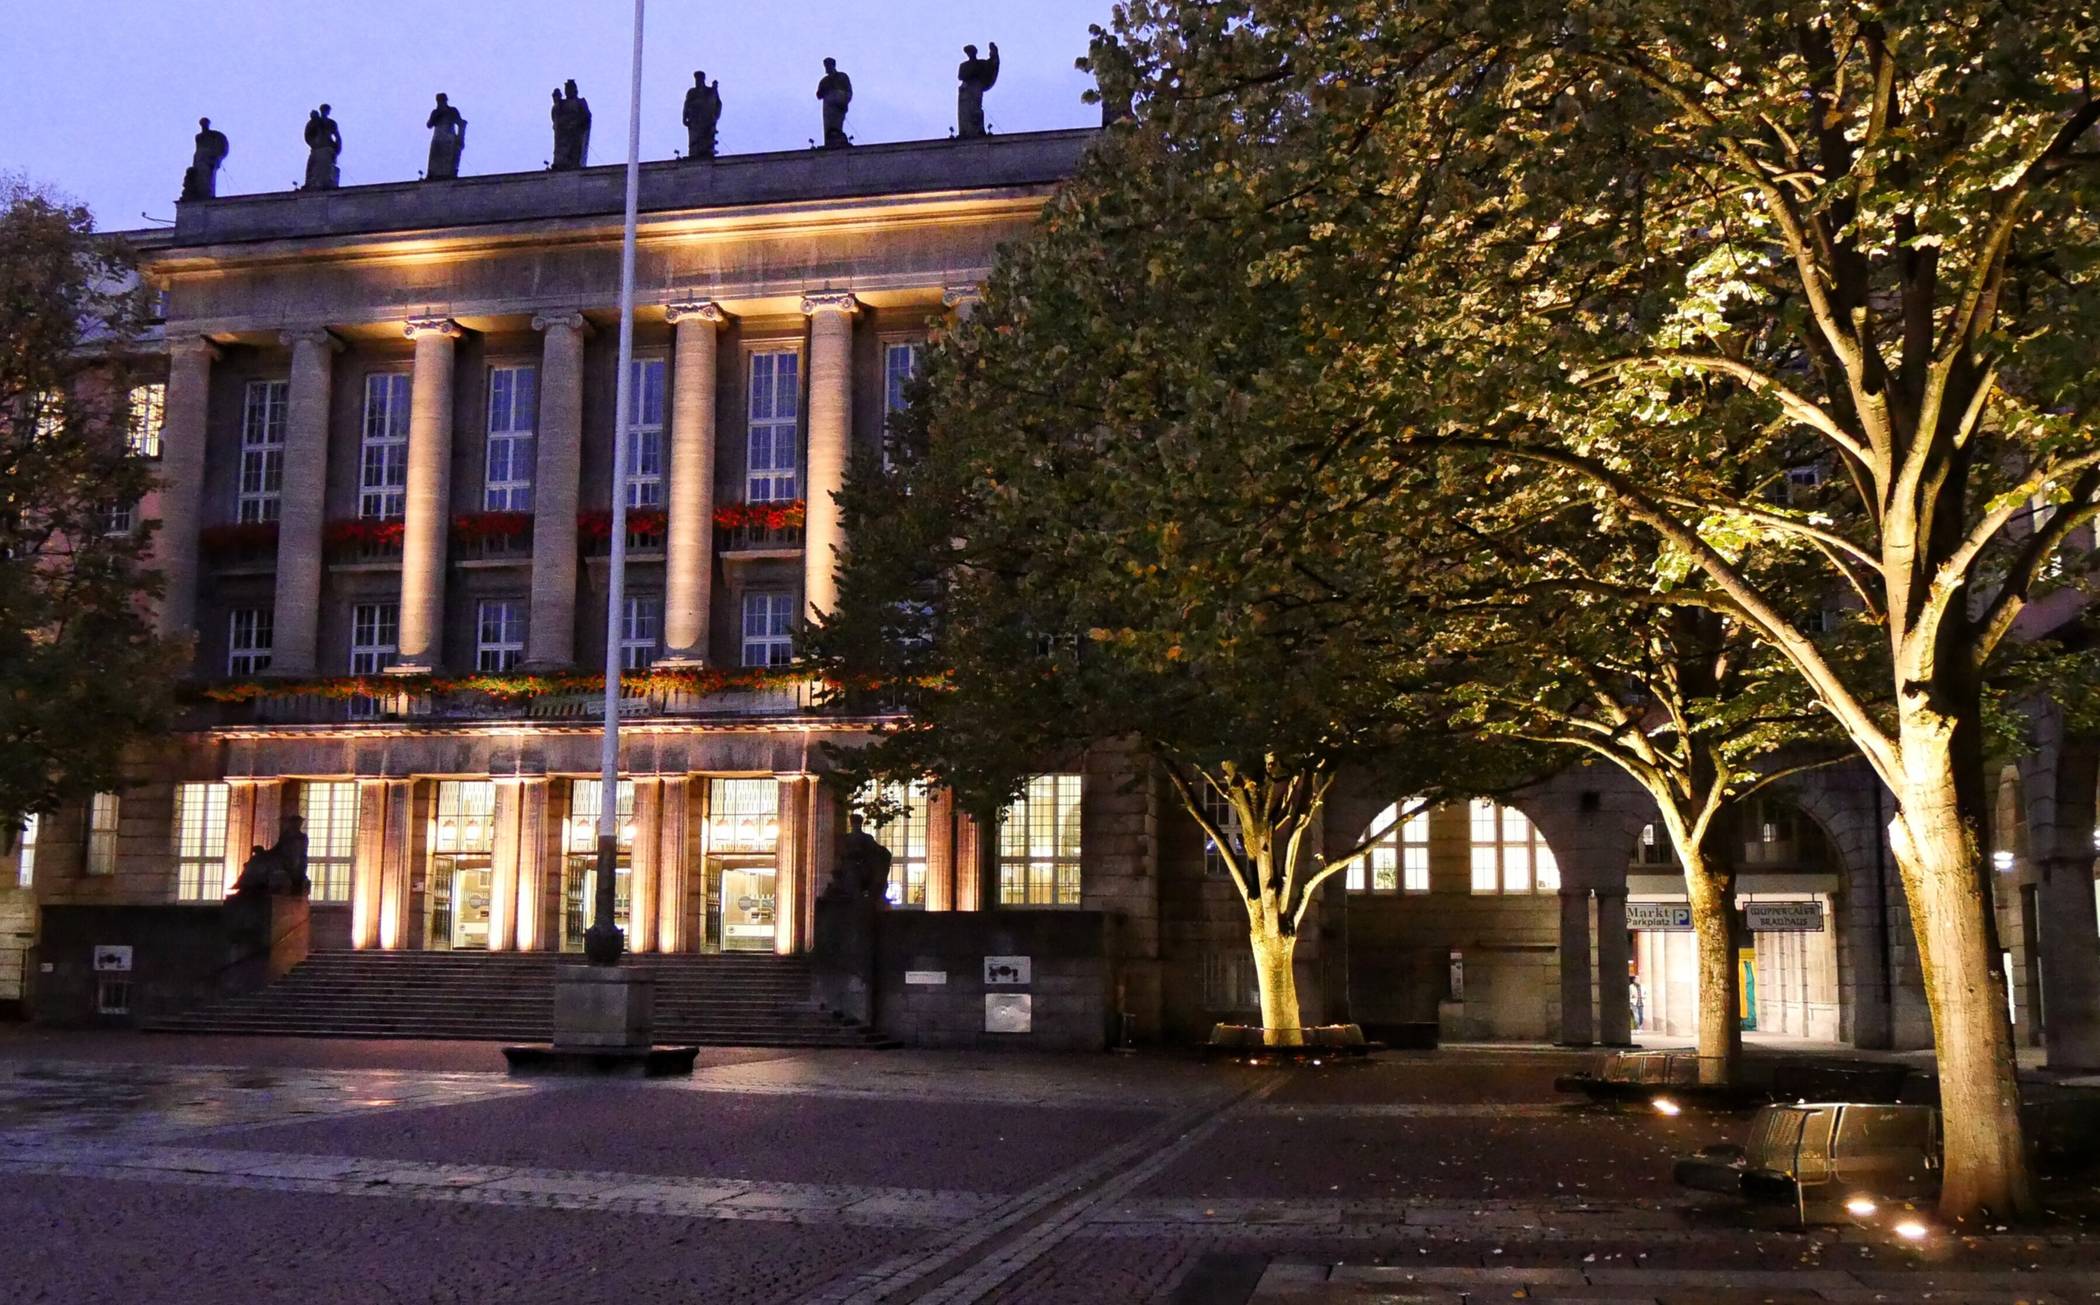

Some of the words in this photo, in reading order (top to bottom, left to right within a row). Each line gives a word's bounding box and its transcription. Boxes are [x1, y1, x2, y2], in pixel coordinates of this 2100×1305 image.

[1628, 907, 1669, 917] Markt
[1674, 909, 1688, 925] P
[1627, 918, 1670, 926] Parkplatz
